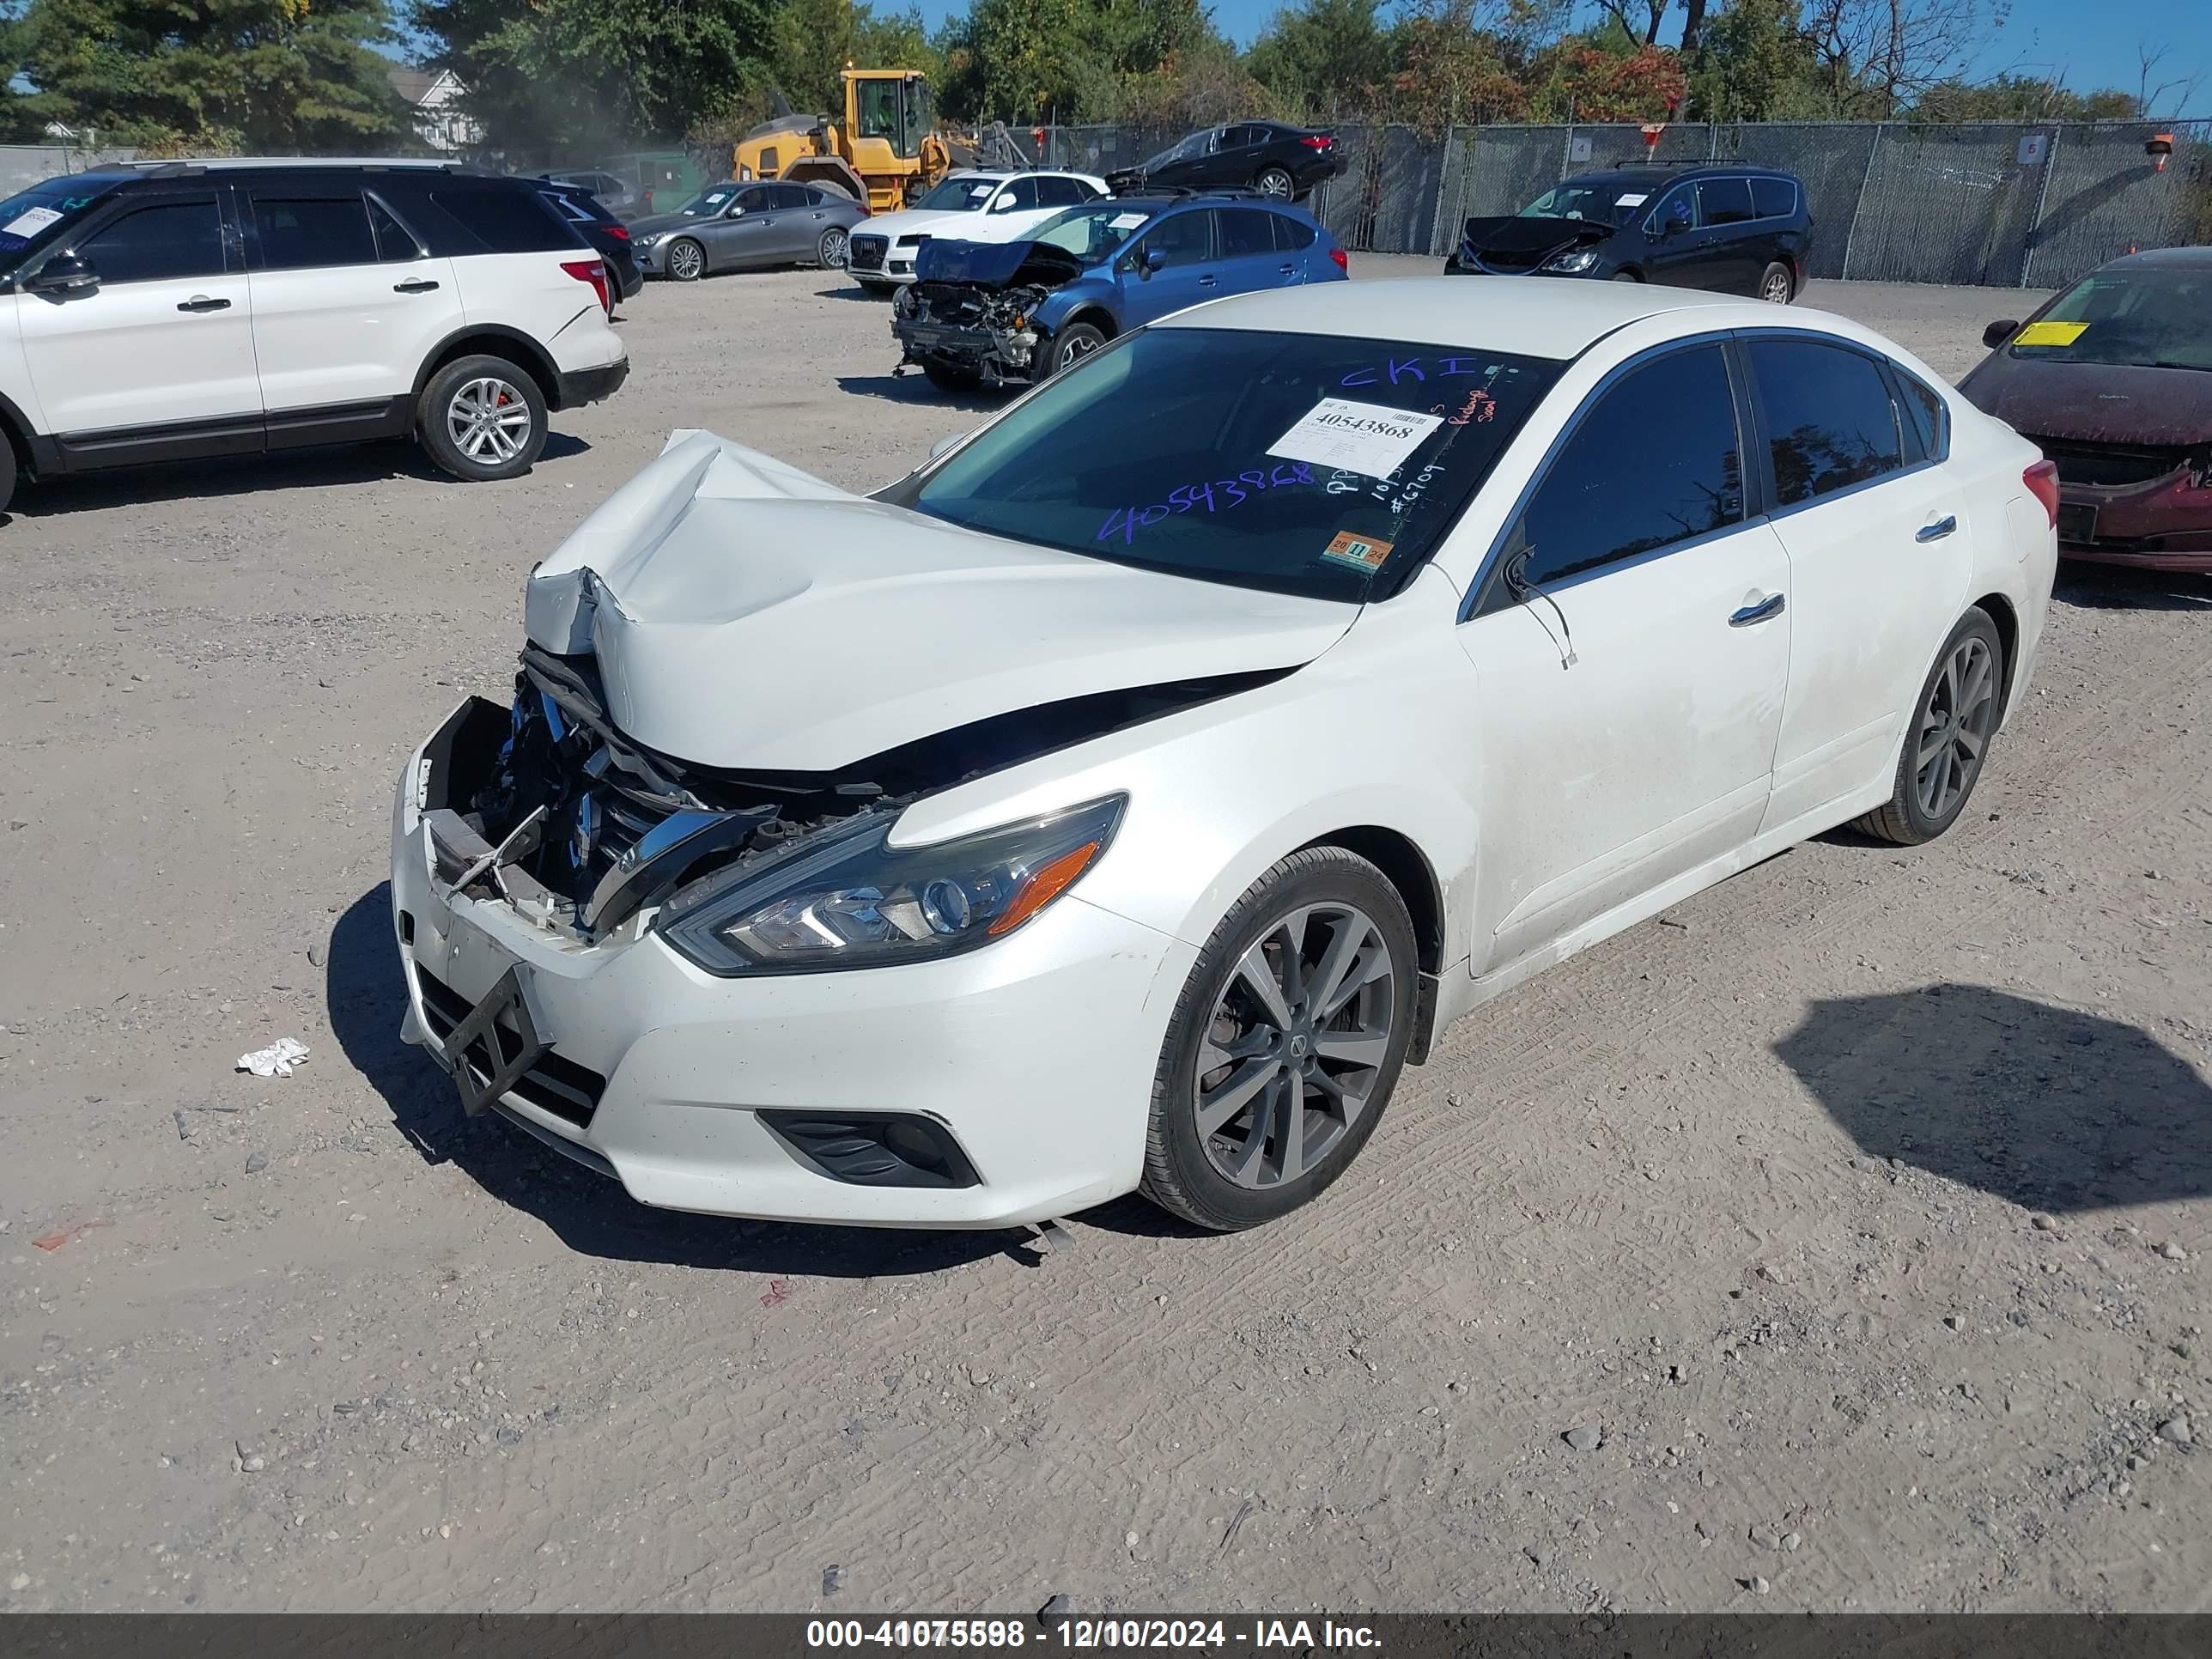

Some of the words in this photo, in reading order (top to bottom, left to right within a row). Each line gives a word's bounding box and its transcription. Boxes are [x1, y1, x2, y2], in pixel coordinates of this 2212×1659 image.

[1315, 412, 1414, 440] 40543868
[1097, 462, 1316, 545] 40543868
[1389, 465, 1446, 514] #6709
[1334, 540, 1347, 550] 20
[1349, 544, 1366, 556] 11
[1369, 550, 1384, 560] 24
